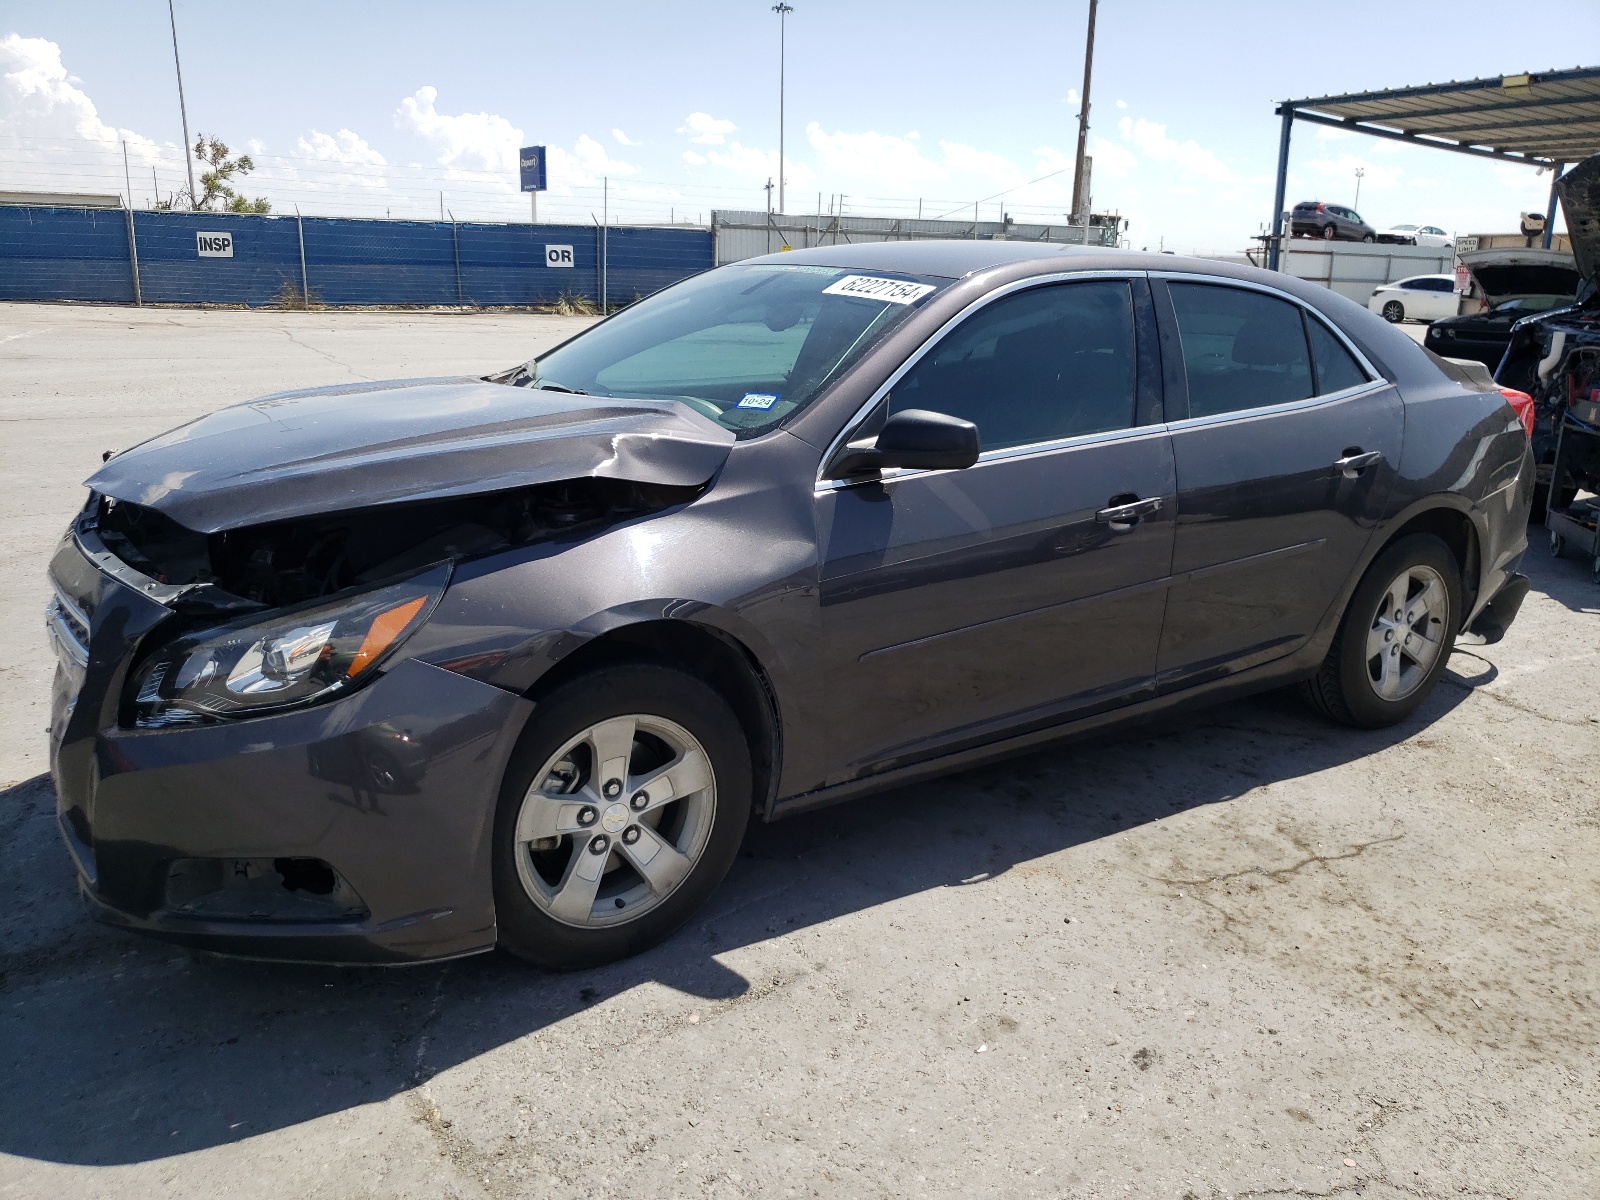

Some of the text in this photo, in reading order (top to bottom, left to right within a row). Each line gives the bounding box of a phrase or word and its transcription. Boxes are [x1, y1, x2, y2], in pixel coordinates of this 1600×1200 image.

[199, 237, 231, 252] INSP
[548, 249, 572, 263] OR
[841, 278, 922, 299] 62227154
